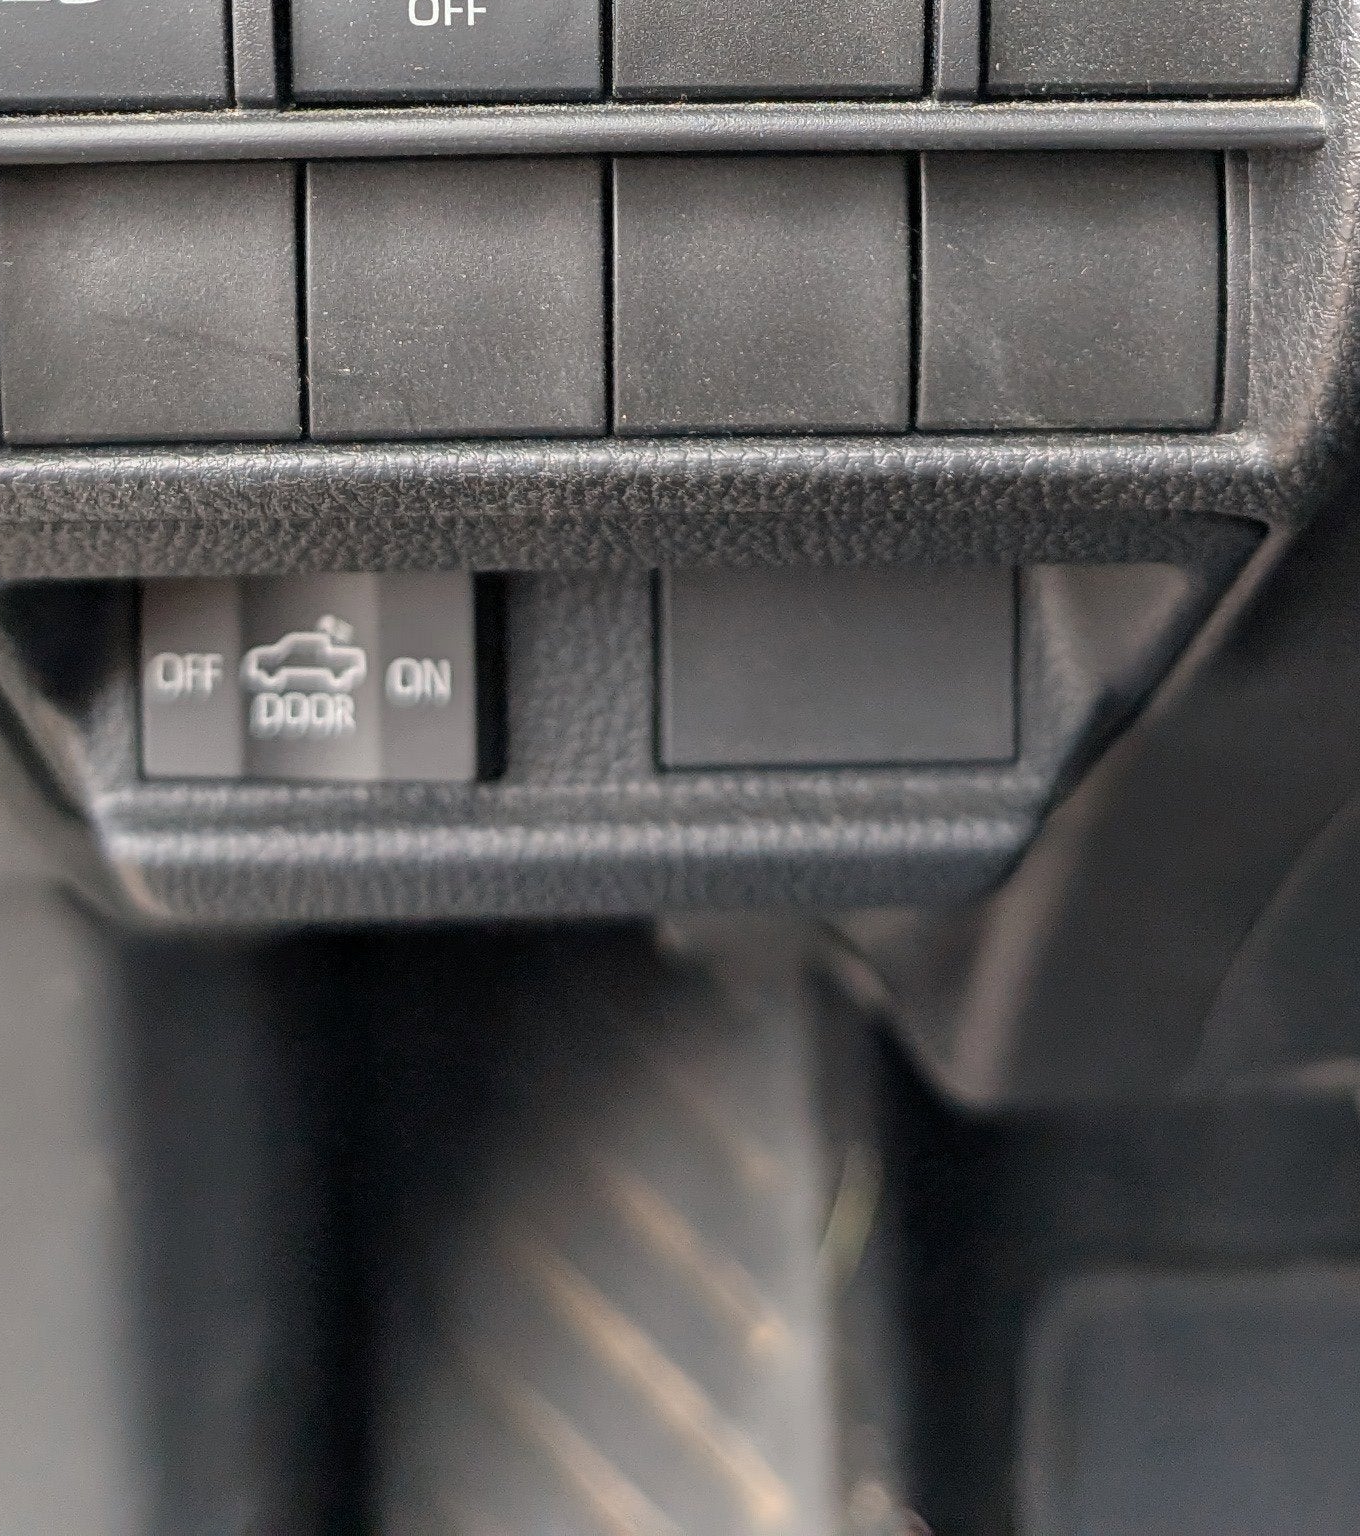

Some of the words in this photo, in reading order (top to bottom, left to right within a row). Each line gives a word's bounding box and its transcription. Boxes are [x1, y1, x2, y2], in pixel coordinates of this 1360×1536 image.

[149, 652, 224, 698] OFF
[386, 658, 452, 702] ON
[252, 693, 356, 736] DOOR
